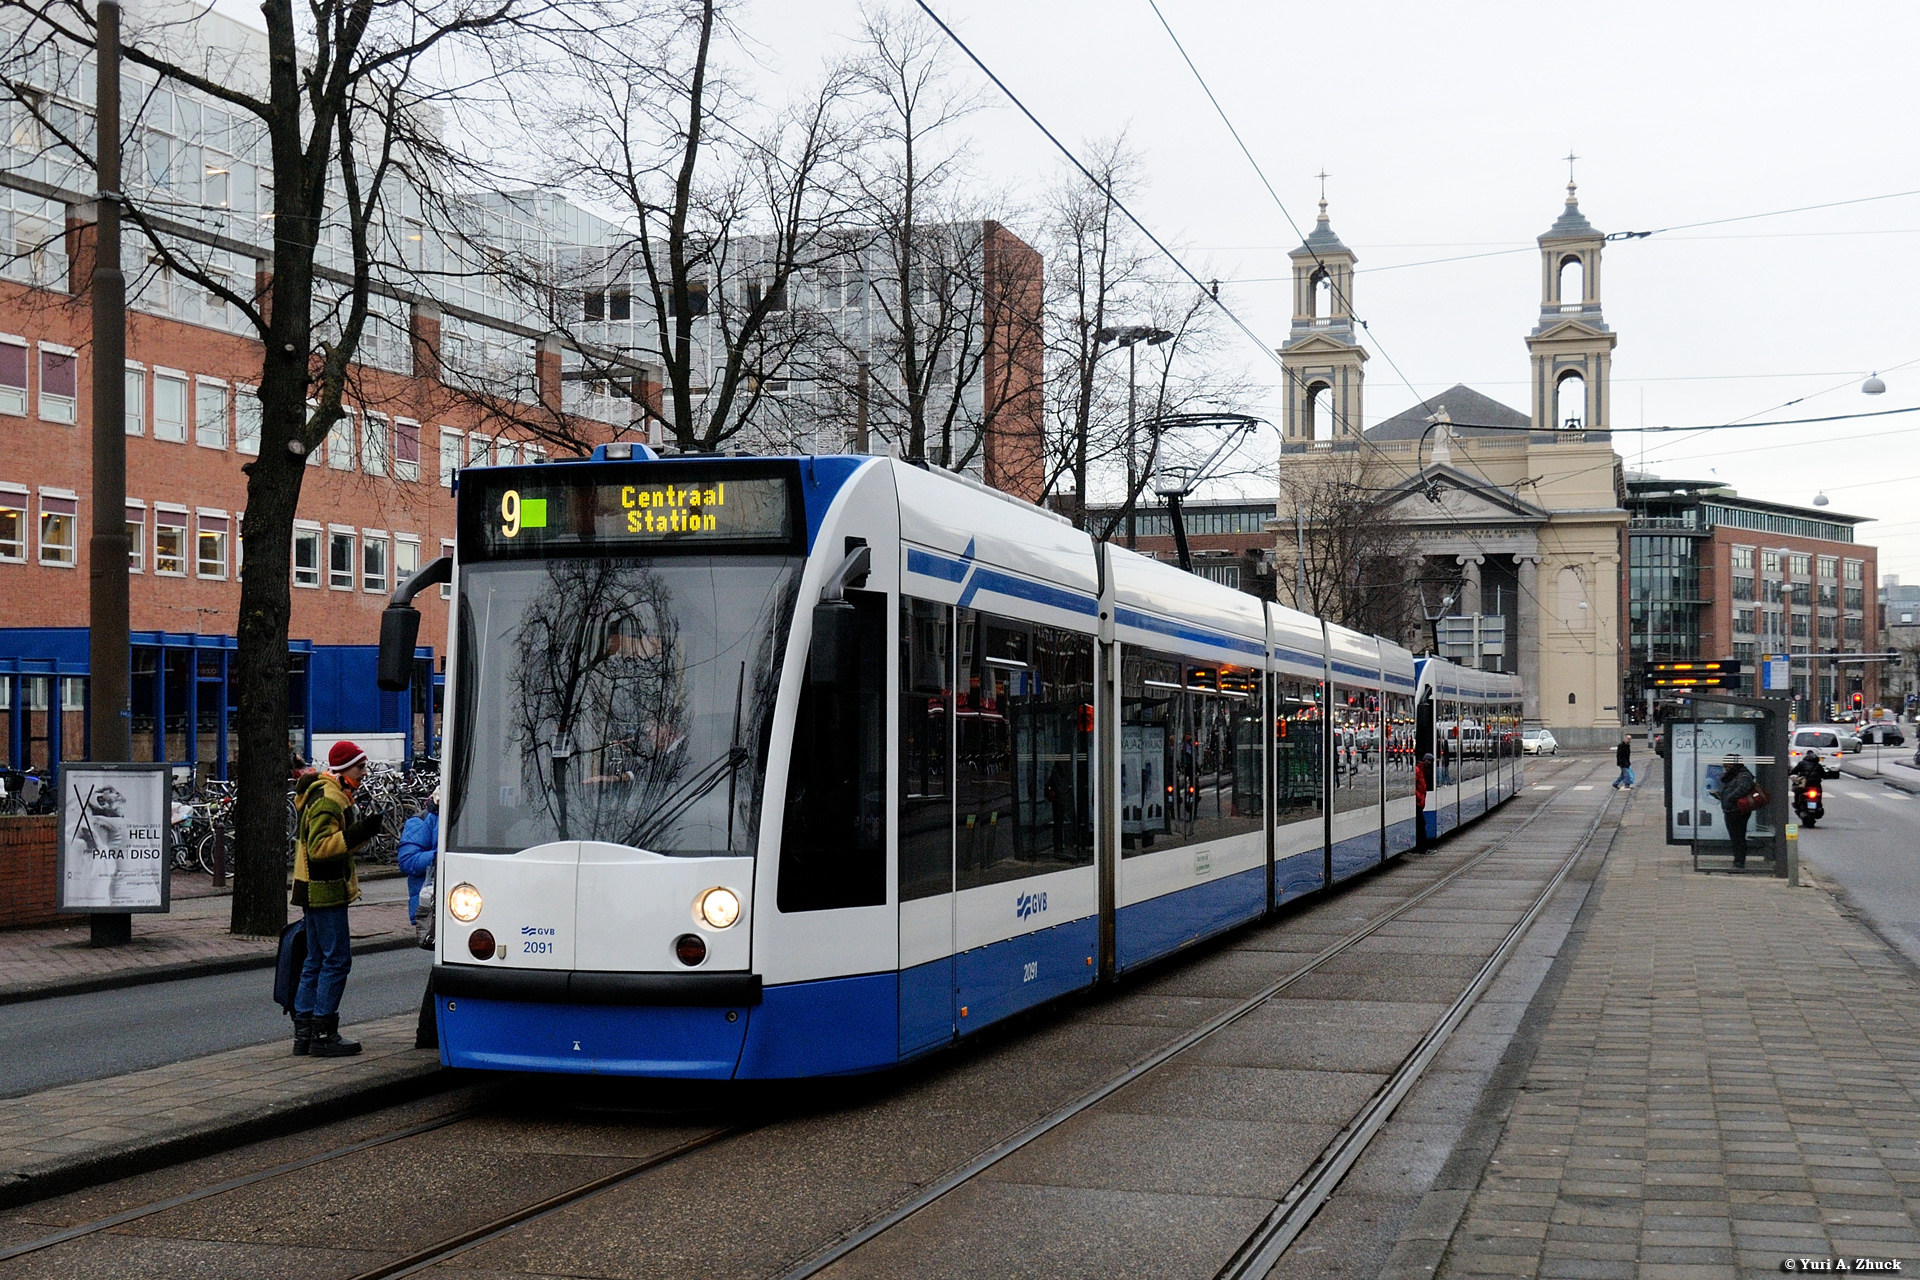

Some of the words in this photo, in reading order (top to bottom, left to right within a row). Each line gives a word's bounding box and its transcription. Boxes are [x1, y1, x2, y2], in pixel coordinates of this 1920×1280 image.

[621, 484, 724, 508] Centraal
[501, 490, 521, 538] 9
[627, 510, 716, 533] Station
[1676, 729, 1712, 738] Samung
[129, 829, 160, 839] HELL
[93, 849, 124, 859] PARA
[131, 849, 160, 859] DISO
[1032, 892, 1047, 913] GVB
[524, 942, 552, 954] 2091
[1024, 961, 1038, 982] 2091
